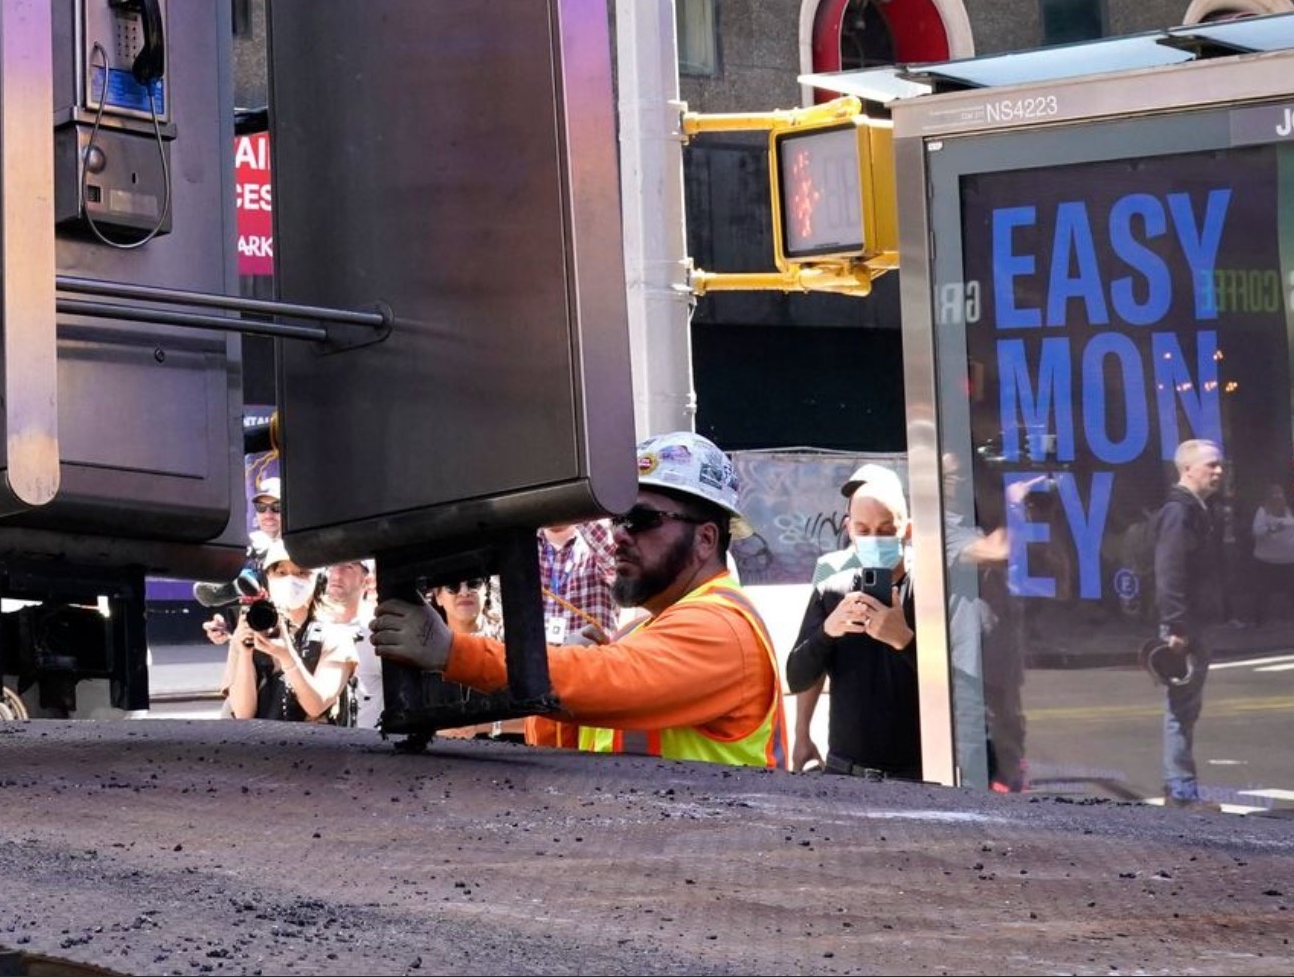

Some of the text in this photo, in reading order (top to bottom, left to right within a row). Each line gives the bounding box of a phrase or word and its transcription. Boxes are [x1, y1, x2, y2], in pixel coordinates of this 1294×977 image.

[986, 95, 1058, 122] NS4223
[992, 188, 1232, 330] EASY
[996, 330, 1223, 466] MON
